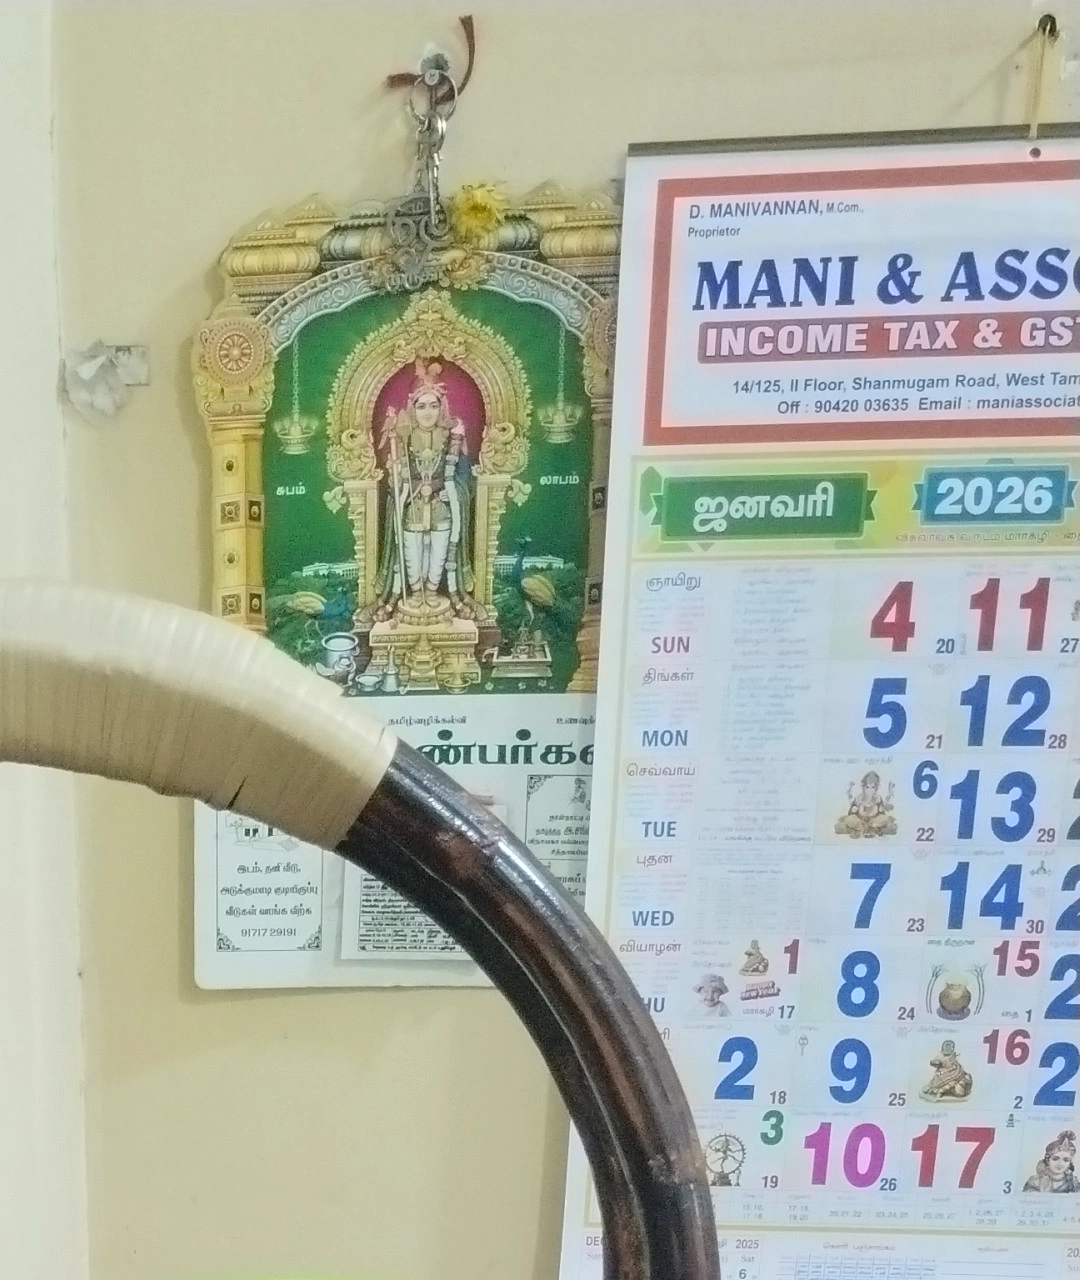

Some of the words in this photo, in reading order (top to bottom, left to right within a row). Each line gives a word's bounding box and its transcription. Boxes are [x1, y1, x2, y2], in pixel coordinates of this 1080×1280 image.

[689, 204, 705, 219] D.
[709, 199, 824, 219] MANIVANNAN,
[688, 226, 741, 240] Proprietor
[692, 255, 859, 311] MANI
[876, 253, 924, 305] &
[940, 247, 1080, 302] ASS
[705, 323, 869, 357] INCOME
[883, 320, 960, 350] TAX
[973, 318, 1003, 349] &
[1021, 316, 1080, 347] GS
[733, 379, 785, 394] 14/125,
[803, 377, 847, 393] Floor,
[851, 375, 950, 393] Shanmugam
[954, 373, 1000, 389] Road,
[1005, 372, 1045, 386] West
[777, 400, 801, 414] Off
[814, 400, 859, 413] 90420
[863, 398, 909, 412] 03635
[918, 396, 962, 411] Email
[934, 477, 1053, 515] 2026
[693, 481, 835, 532] ஜனவரி
[646, 572, 702, 592] ஞாயிறு
[870, 581, 915, 652] 4
[969, 577, 1051, 652] 11
[651, 636, 690, 654] SUN
[935, 638, 955, 654] 20
[1060, 637, 1079, 653] 27
[642, 667, 694, 686] திங்கள்
[862, 678, 907, 749] 5
[960, 675, 1051, 747] 12
[642, 730, 689, 747] MON
[925, 734, 944, 749] 21
[1047, 734, 1067, 749] 28
[626, 762, 696, 777] செவ்வாய்
[913, 760, 939, 799] 6
[950, 769, 1037, 842] 13
[642, 821, 677, 838] TUE
[916, 827, 935, 842] 22
[1037, 828, 1056, 843] 29
[636, 852, 673, 868] புதன்
[850, 863, 892, 929] 7
[940, 861, 1024, 930] 14
[632, 910, 675, 927] WED
[906, 918, 925, 933] 23
[1026, 919, 1045, 934] 30
[619, 940, 682, 957] வியாழன்
[784, 939, 800, 974] 1
[993, 940, 1040, 977] 15
[837, 951, 880, 1018] 8
[778, 1005, 795, 1019] 17
[897, 1007, 915, 1021] 24
[1025, 1009, 1032, 1023] 1
[983, 1029, 1031, 1066] 16
[714, 1036, 758, 1100] 2
[829, 1038, 871, 1103] 9
[769, 1091, 787, 1105] 18
[888, 1093, 906, 1107] 25
[1013, 1096, 1023, 1110] 2
[760, 1110, 784, 1145] 3
[804, 1122, 886, 1188] 10
[911, 1124, 996, 1188] 17
[761, 1175, 778, 1189] 19
[879, 1177, 897, 1191] 26
[1003, 1180, 1012, 1194] 3
[735, 1239, 759, 1249] 2025
[738, 1269, 747, 1279] 6
